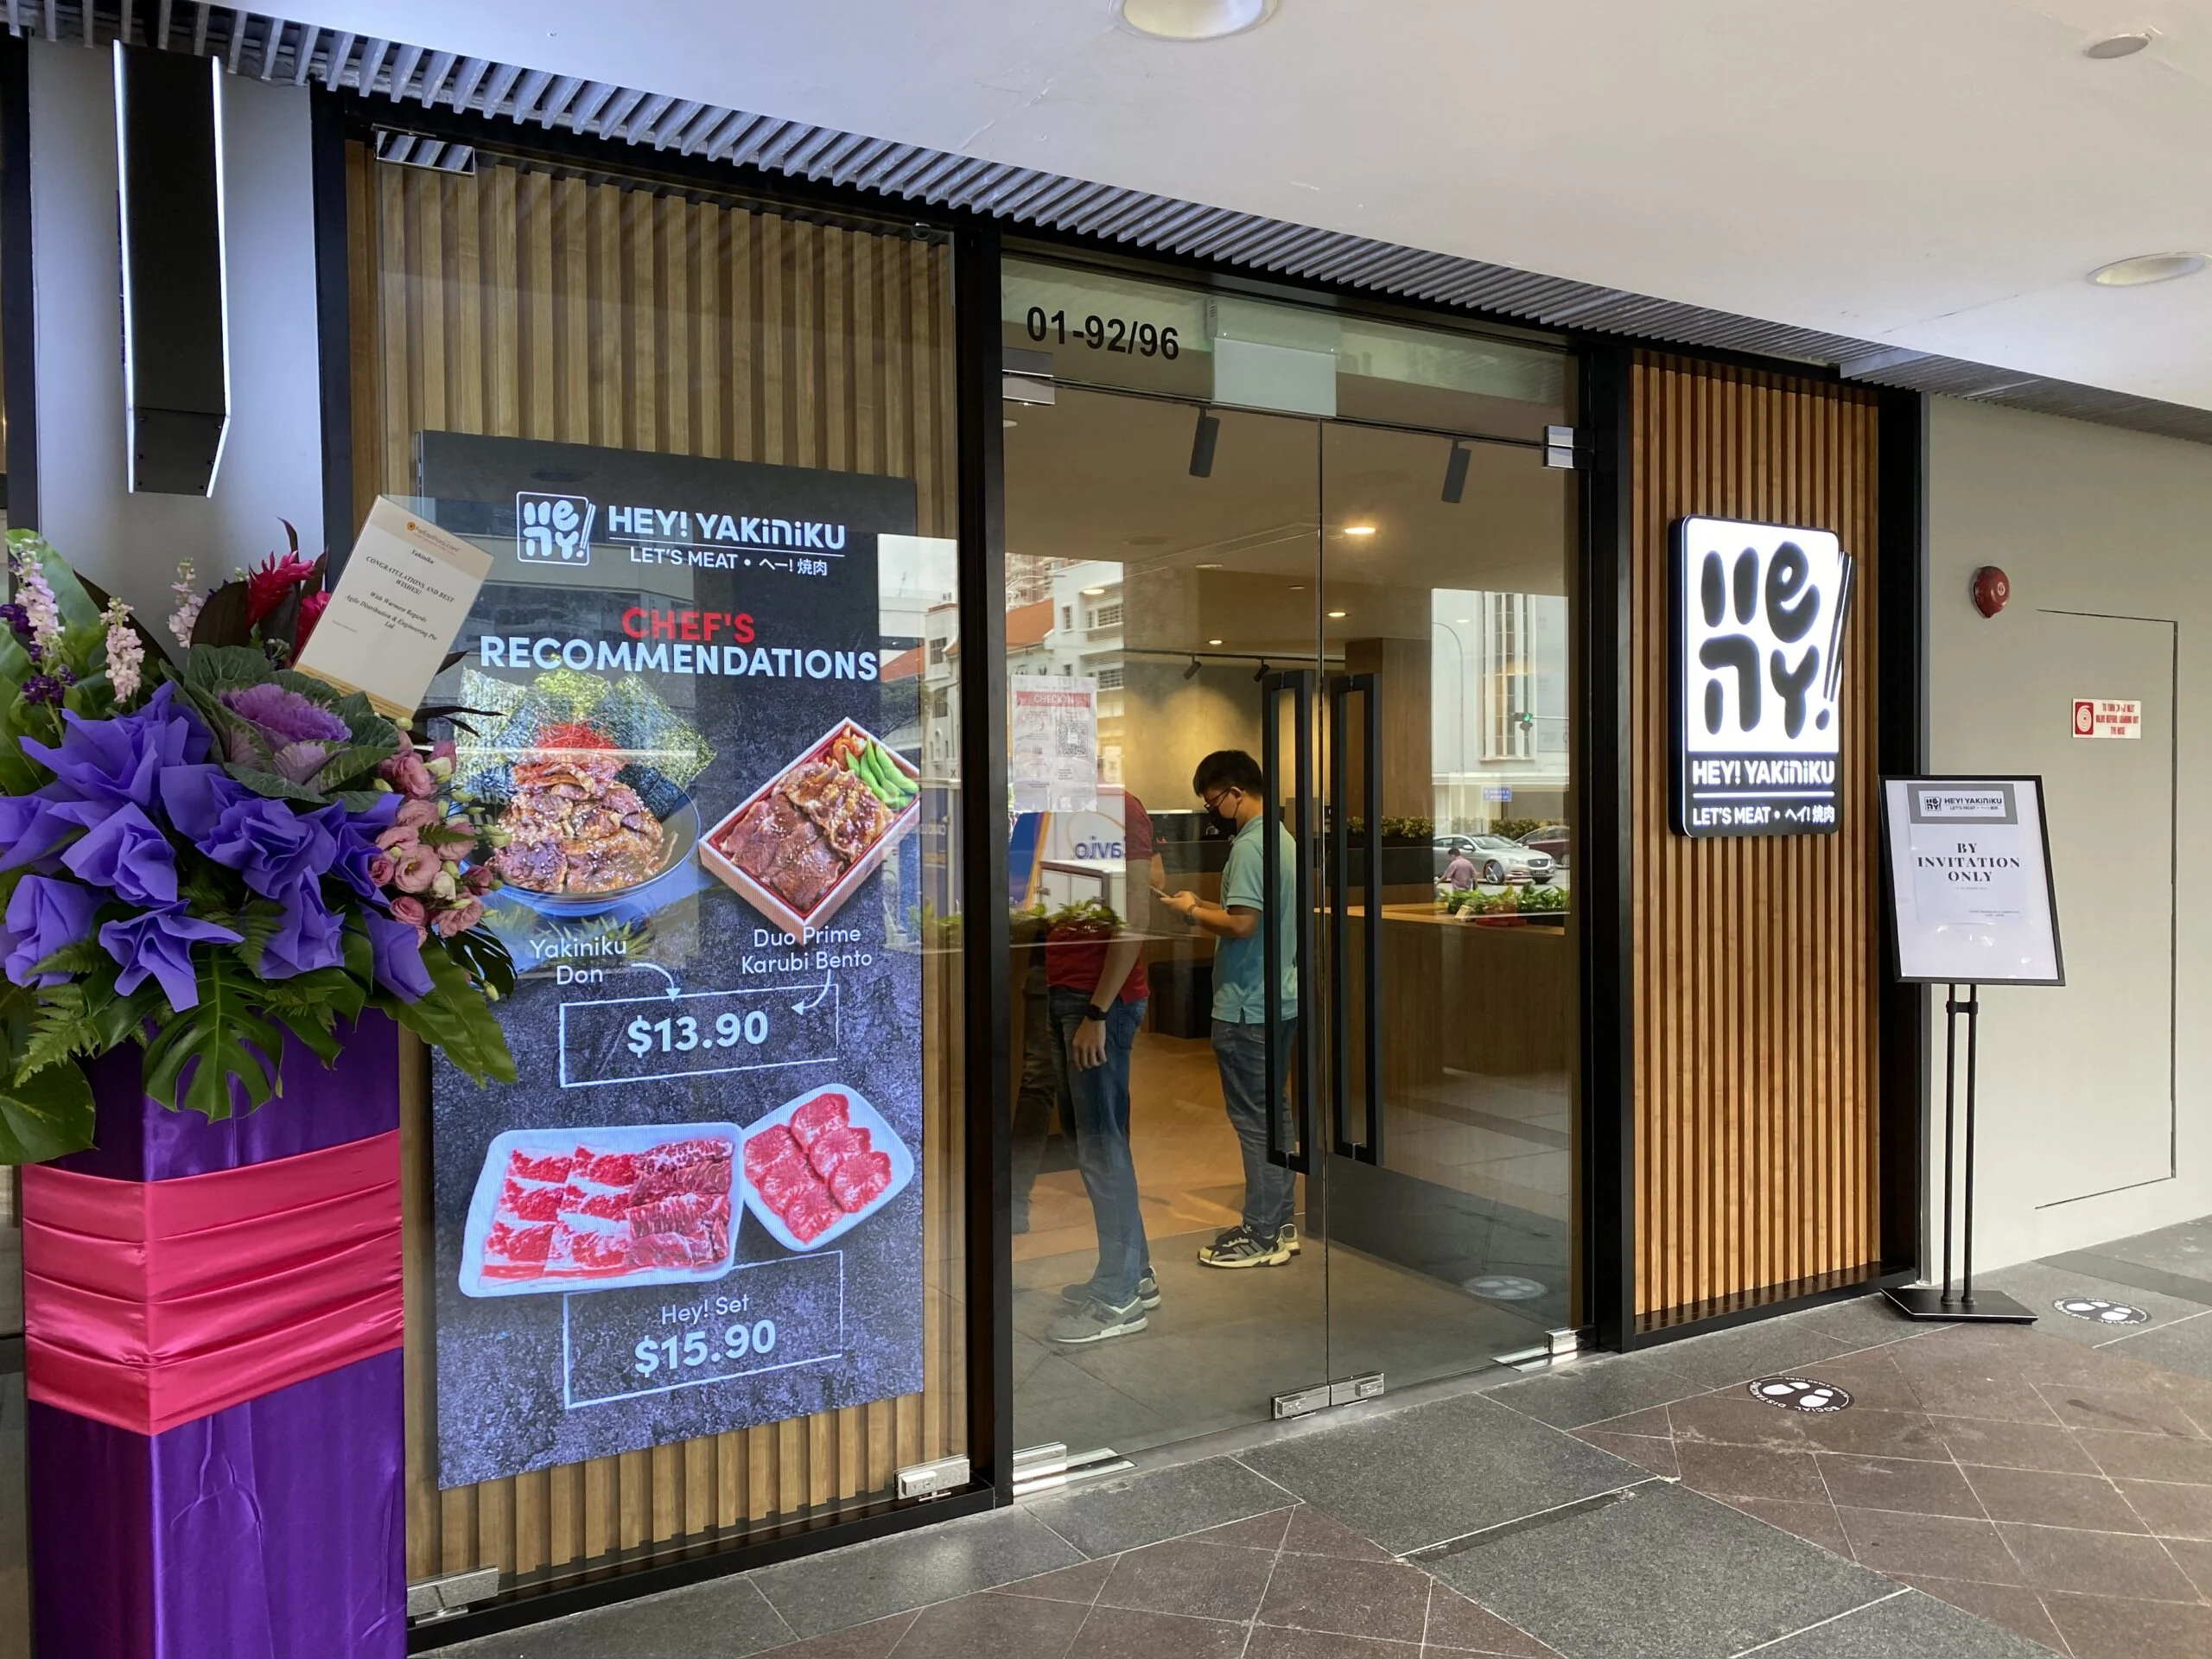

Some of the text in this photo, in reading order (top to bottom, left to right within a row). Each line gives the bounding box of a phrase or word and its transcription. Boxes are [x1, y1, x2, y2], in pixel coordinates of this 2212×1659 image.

[1027, 306, 1179, 360] 01-92/96
[608, 505, 688, 537] HEY!
[411, 549, 435, 564] Yakiniku
[630, 546, 683, 565] LET'S
[688, 550, 738, 569] MEAT
[365, 556, 455, 603] CONGRATULATIONS AND BEST
[396, 579, 423, 595] WISHES!
[370, 591, 427, 623] With Warmest Regards
[621, 607, 755, 643] CHEF'S
[480, 635, 878, 681] RECOMMENDATIONS
[1033, 694, 1063, 704] CHECK
[1692, 760, 1741, 785] HEY!
[1692, 806, 1732, 826] LET'S
[1733, 806, 1771, 825] MEAT
[1956, 842, 1977, 854] BY
[1917, 856, 2020, 868] INVITATION
[1948, 871, 1993, 882] ONLY
[531, 935, 627, 960] Yakiniku
[754, 925, 861, 948] Duo Prime
[556, 965, 603, 985] Don
[742, 950, 873, 975] Karubi Bento
[626, 1010, 769, 1058] $13.90
[661, 1294, 750, 1325] Hey! Set
[634, 1319, 776, 1378] $15.90
